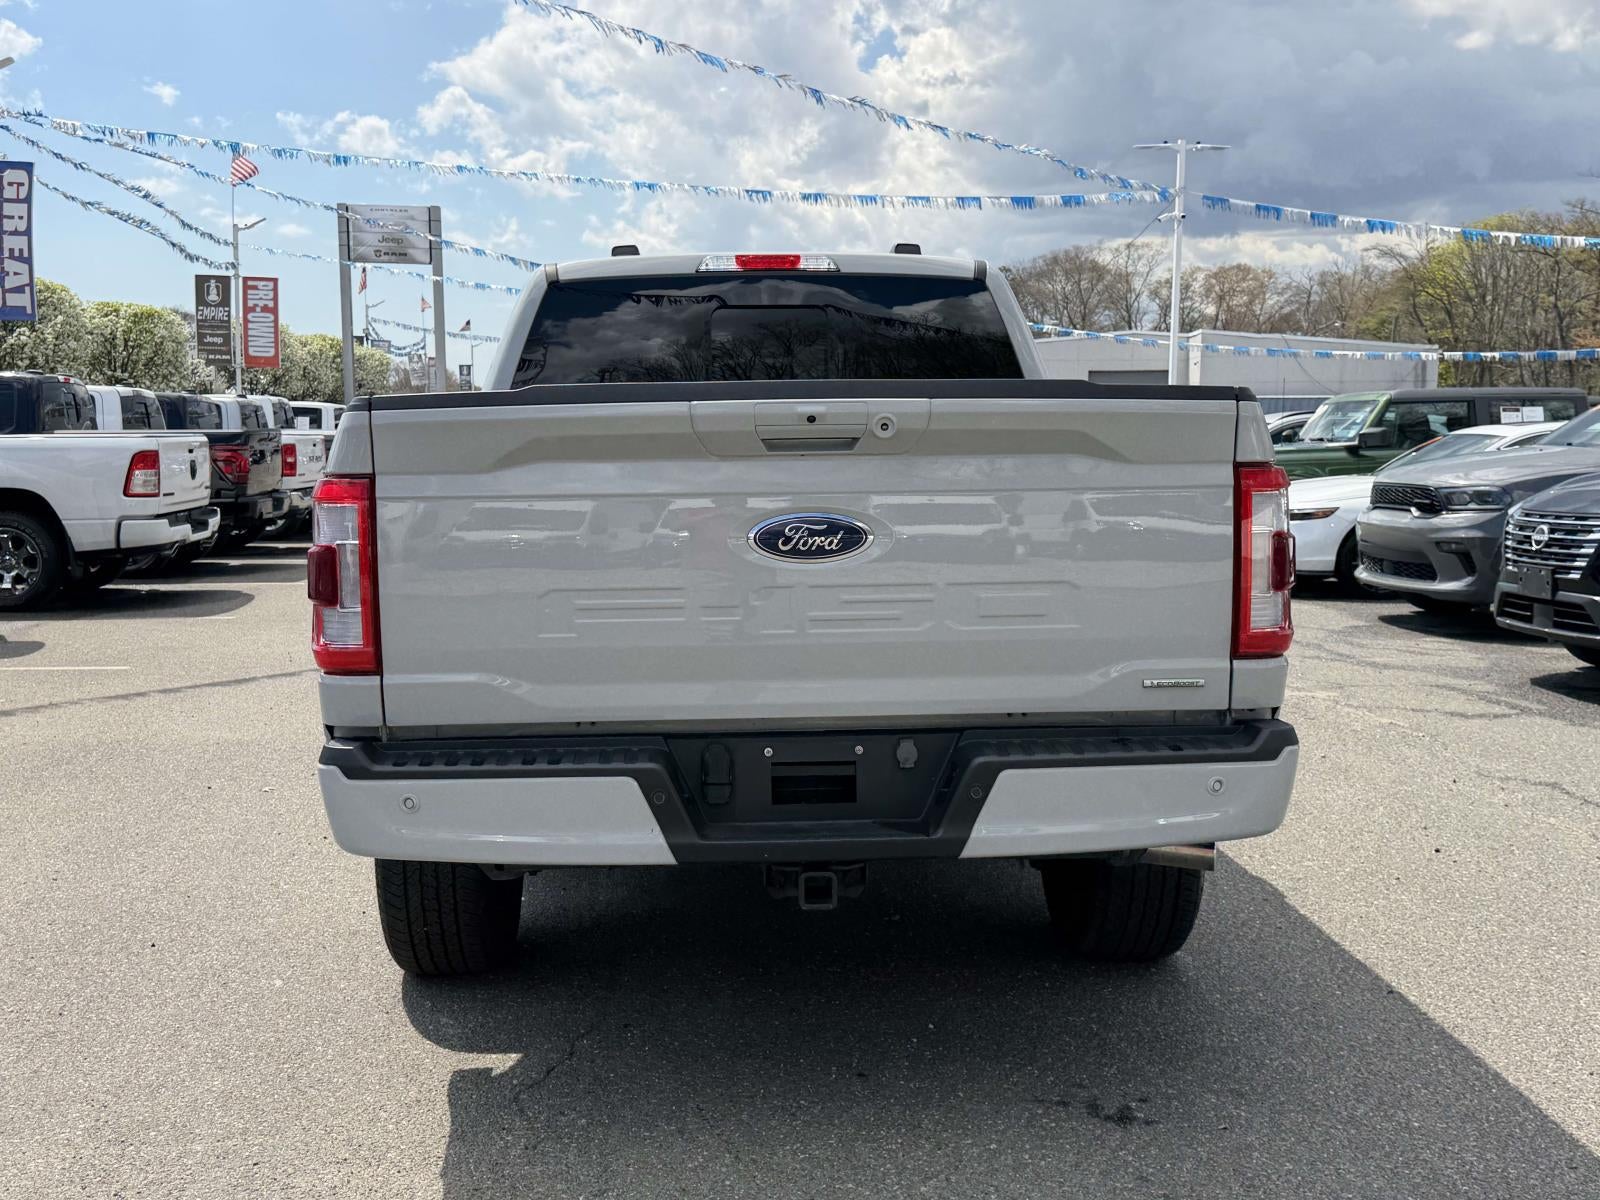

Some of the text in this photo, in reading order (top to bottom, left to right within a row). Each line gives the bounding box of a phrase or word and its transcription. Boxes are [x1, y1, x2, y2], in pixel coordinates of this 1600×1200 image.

[3, 169, 32, 314] GREAT
[378, 235, 404, 246] Jeep
[197, 306, 230, 321] EMPIRE
[203, 335, 224, 345] Jeep
[778, 523, 844, 551] Ford
